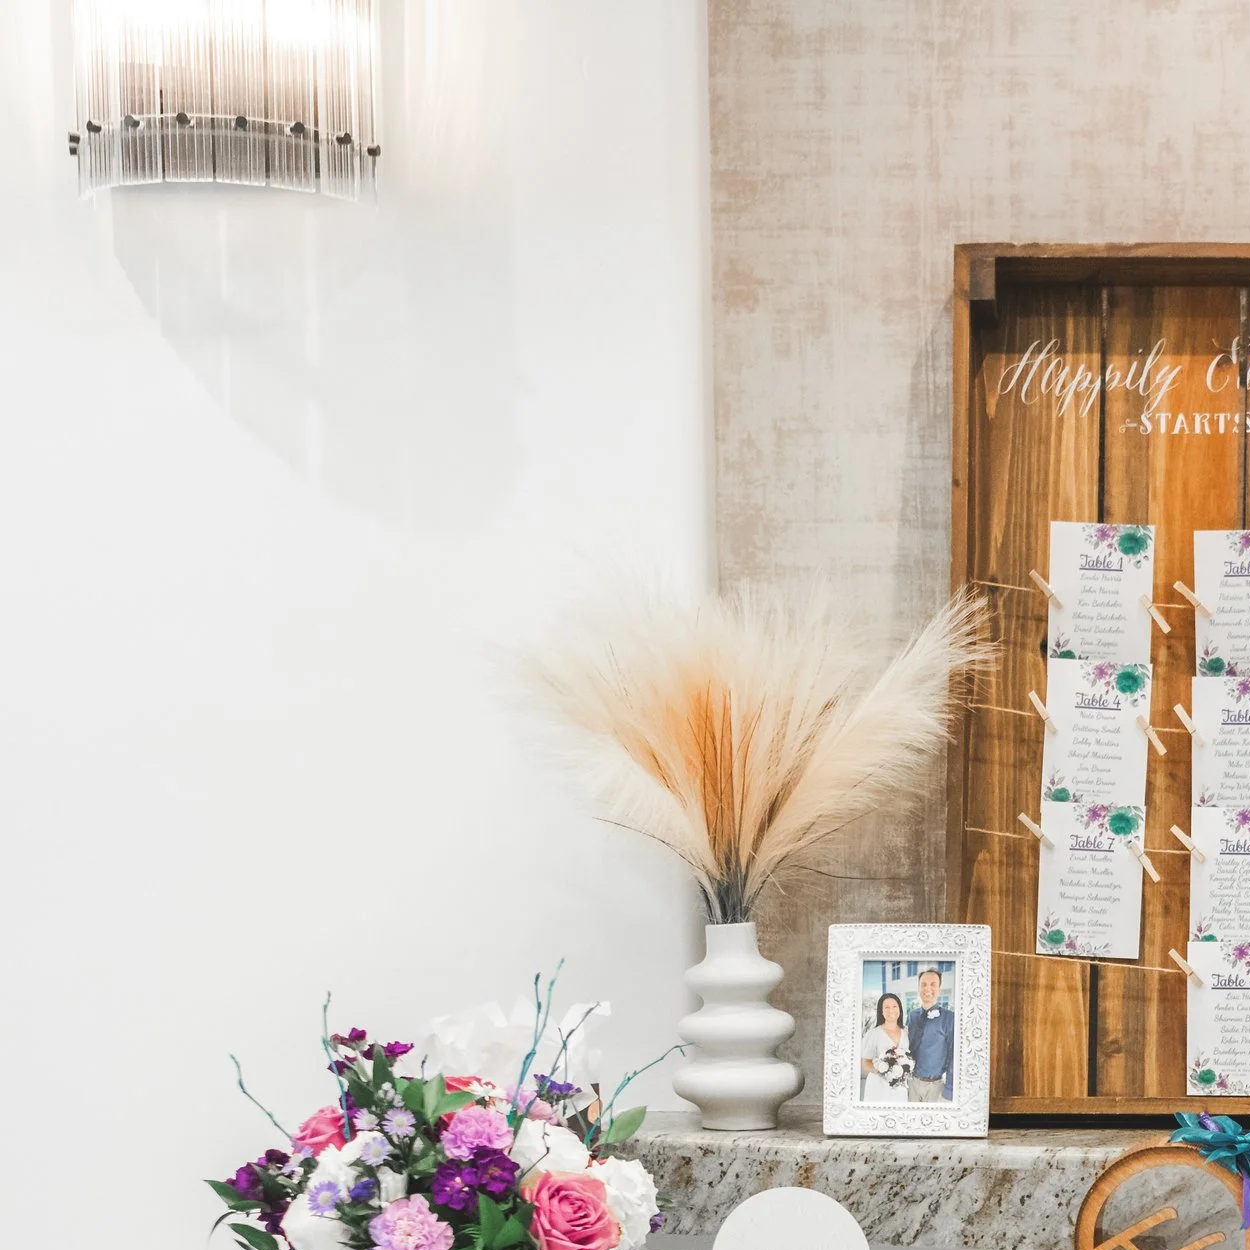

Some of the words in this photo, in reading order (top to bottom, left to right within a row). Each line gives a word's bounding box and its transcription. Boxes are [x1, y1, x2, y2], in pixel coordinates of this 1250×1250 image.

[998, 337, 1184, 418] Happily
[1080, 554, 1113, 568] Table
[1117, 557, 1123, 569] 1
[1076, 692, 1109, 706] Table
[1113, 695, 1120, 708] 4
[1070, 835, 1104, 849] Table
[1108, 837, 1115, 850] 7
[1212, 974, 1246, 987] Table
